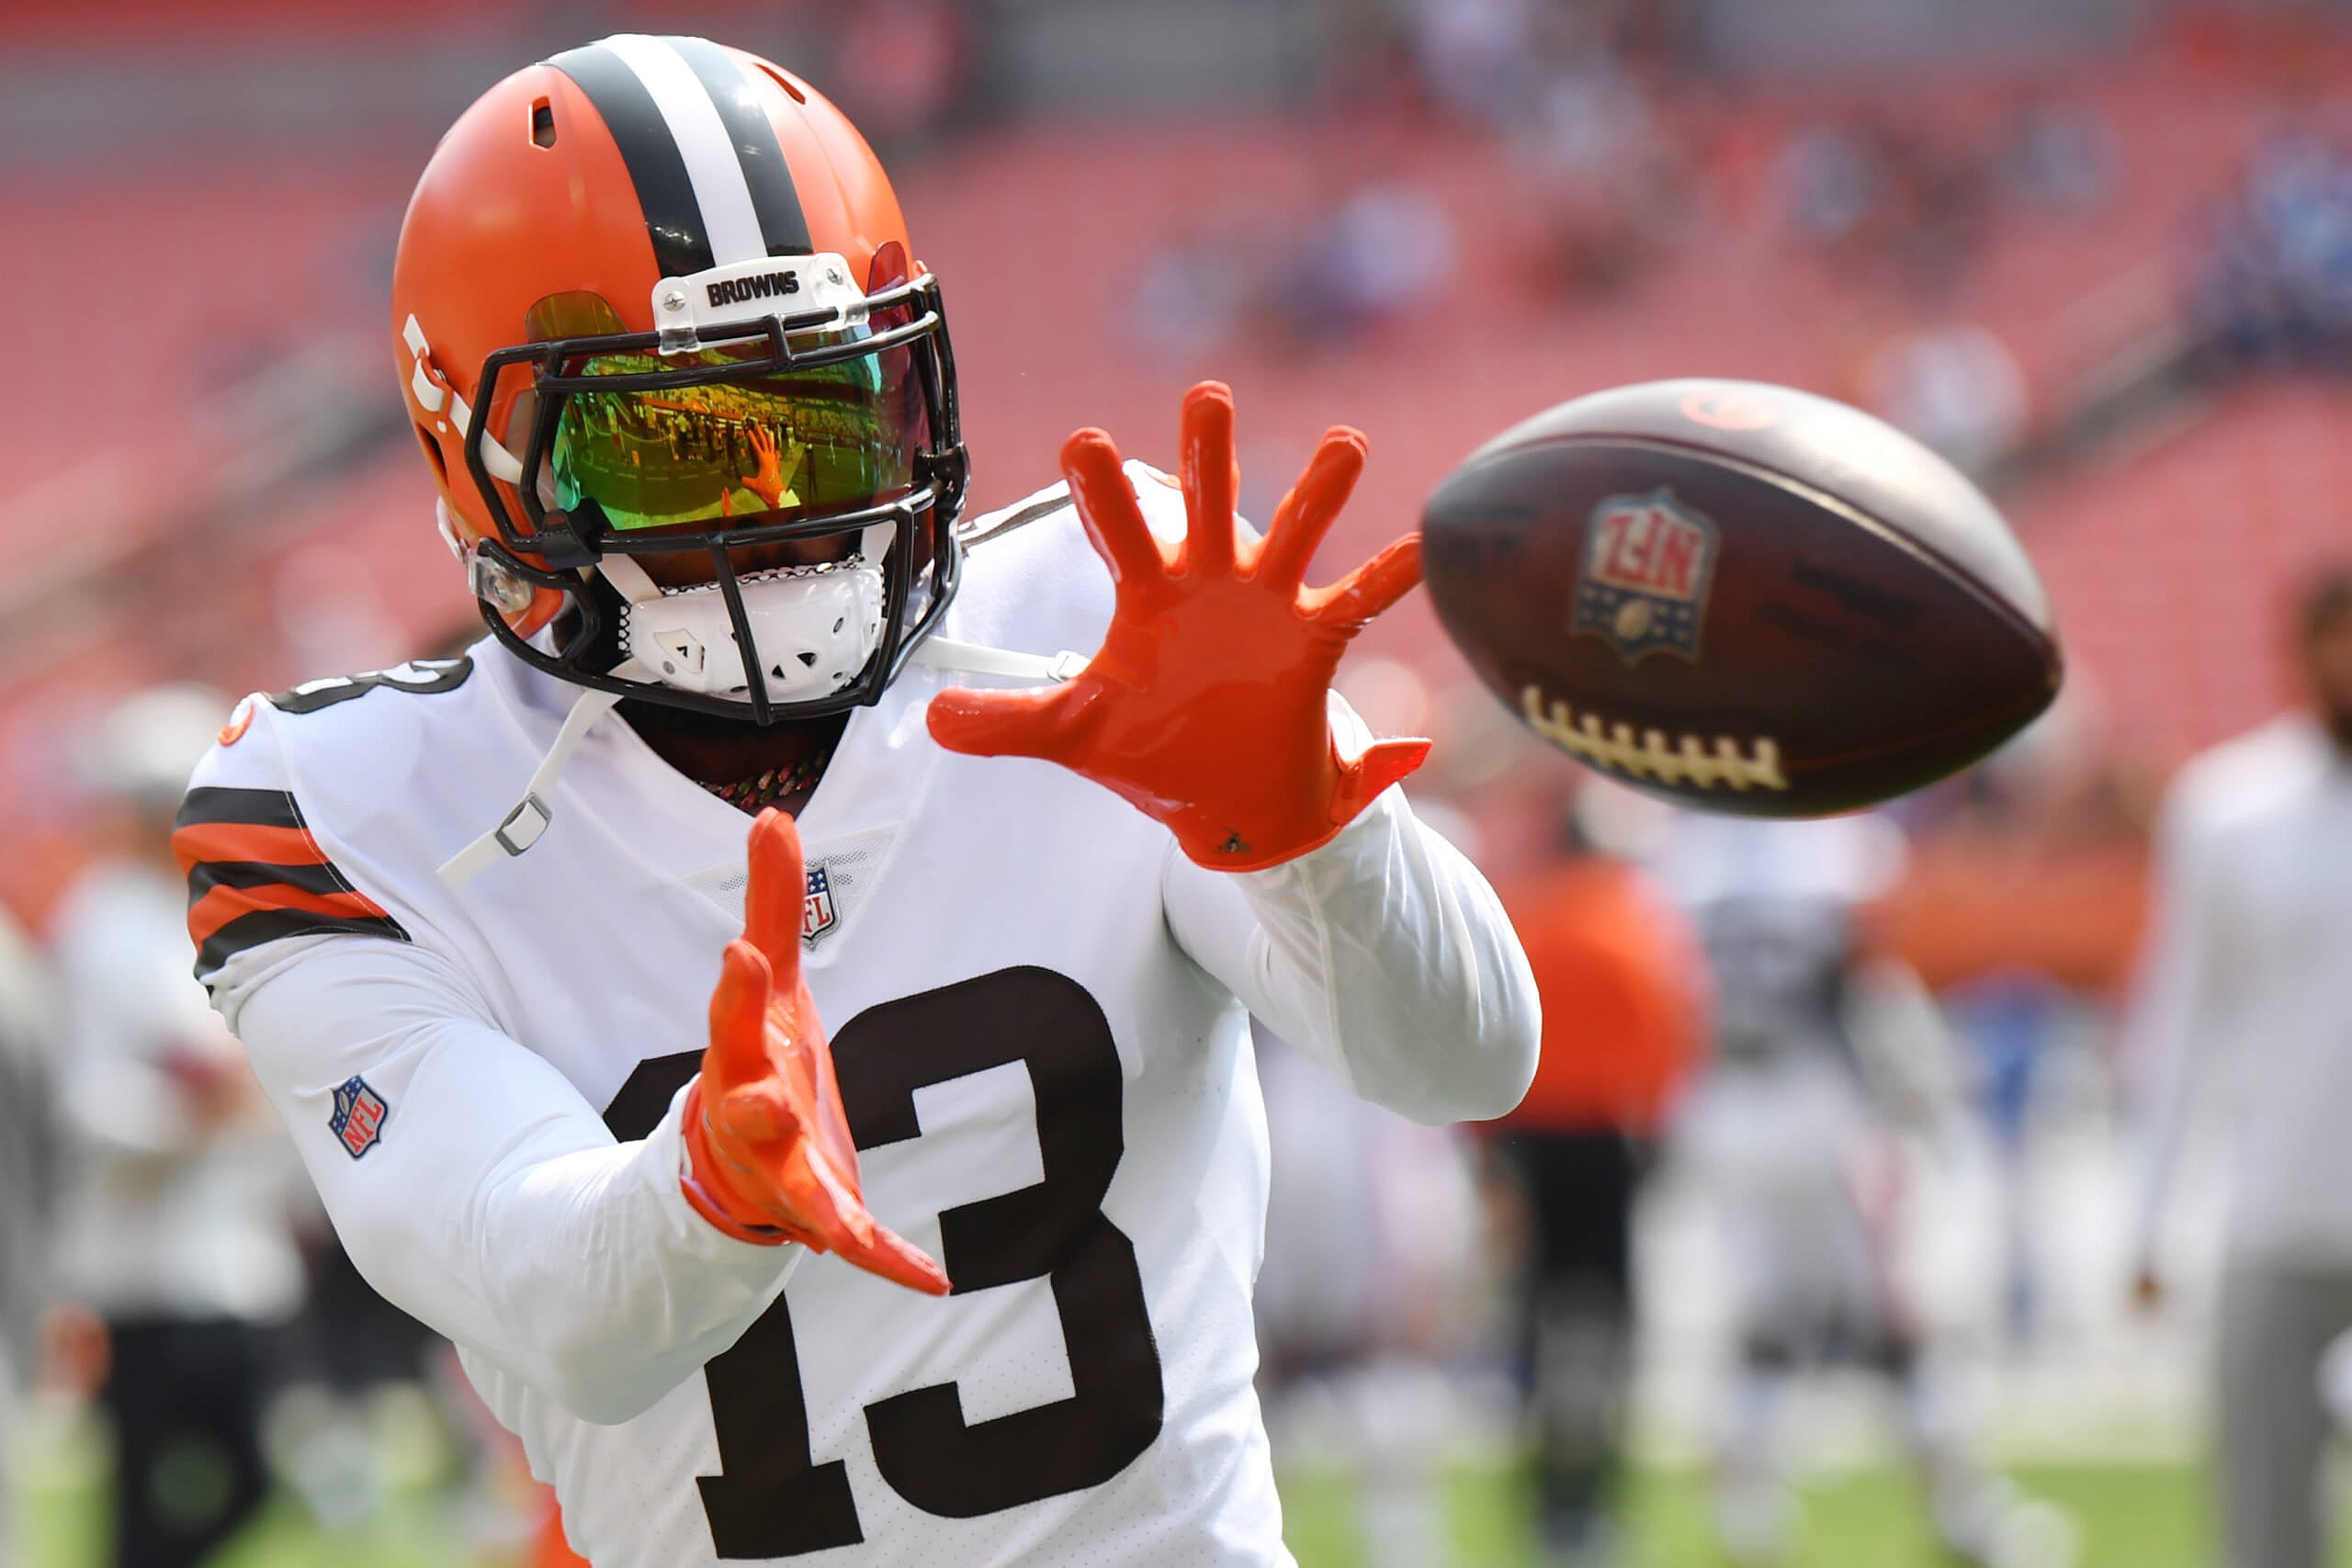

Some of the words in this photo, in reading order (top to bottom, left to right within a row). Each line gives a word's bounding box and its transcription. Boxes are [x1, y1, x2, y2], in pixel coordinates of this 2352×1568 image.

[707, 270, 800, 308] BROWNS
[1601, 511, 1702, 594] NFL
[803, 896, 831, 933] FL
[344, 1096, 383, 1154] NFL
